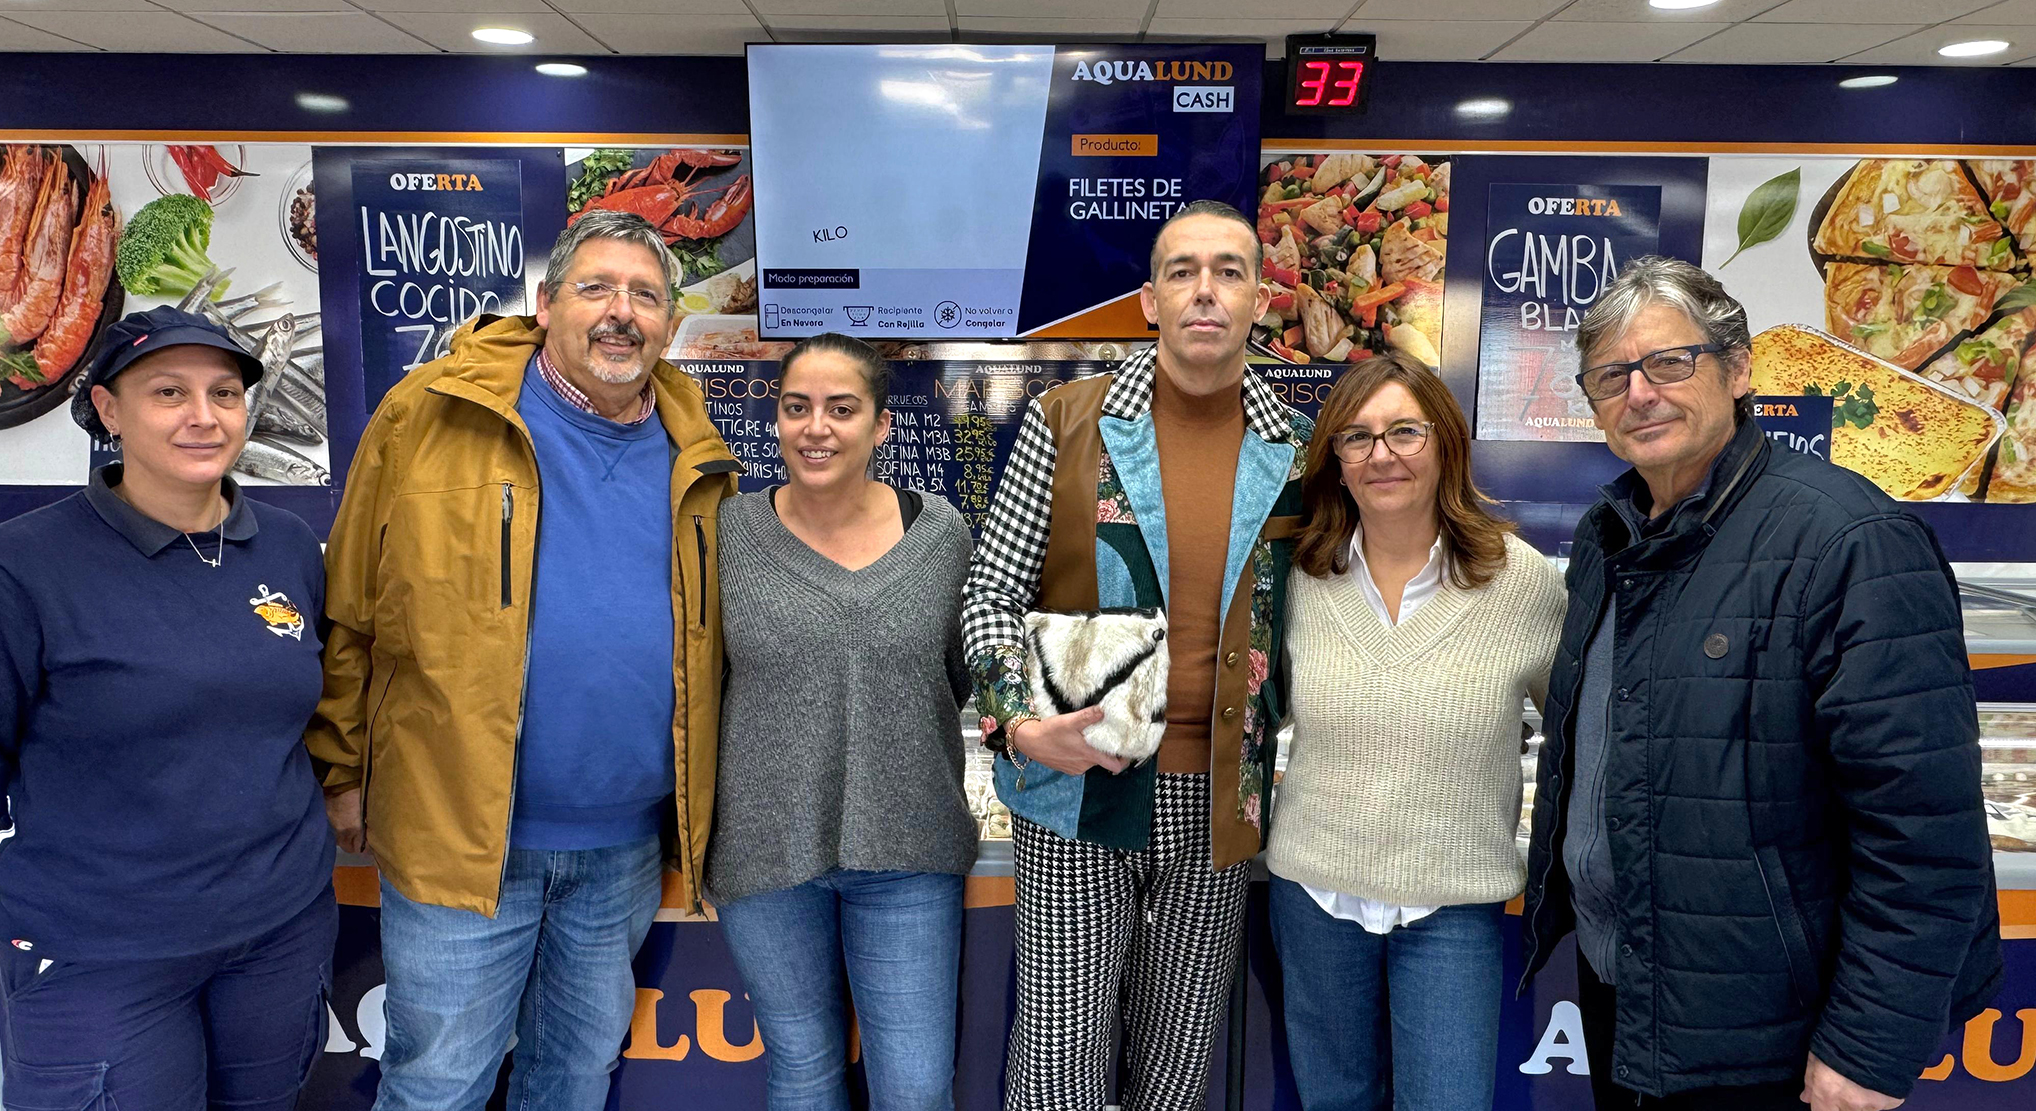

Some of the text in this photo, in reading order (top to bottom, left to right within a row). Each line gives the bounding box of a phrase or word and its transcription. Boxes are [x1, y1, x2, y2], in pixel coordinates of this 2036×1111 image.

[1071, 60, 1233, 85] AQUALUND
[1295, 61, 1363, 106] 33
[1176, 92, 1230, 108] CASH
[1080, 138, 1141, 151] Producto:
[389, 173, 483, 191] OFERTA
[1069, 178, 1182, 197] FILETES DE
[1527, 197, 1622, 216] OFERTA
[812, 225, 848, 243] KILO
[1488, 228, 1618, 305] GAMBA
[768, 273, 854, 285] Modo preparación
[877, 306, 923, 316] Recipiente
[965, 307, 977, 315] No
[978, 307, 1005, 315] volver
[781, 319, 824, 327] En Nevera
[877, 320, 925, 330] Con Rejilla
[965, 319, 1005, 328] Congelar
[679, 364, 744, 375] AQUALUND
[1265, 369, 1332, 379] AQUALUND
[886, 395, 928, 407] RRUECOS
[924, 413, 941, 427] M2
[922, 429, 951, 445] M3A
[925, 446, 951, 461] M3B
[876, 459, 944, 477] SOFINA M4
[930, 478, 947, 492] 5X
